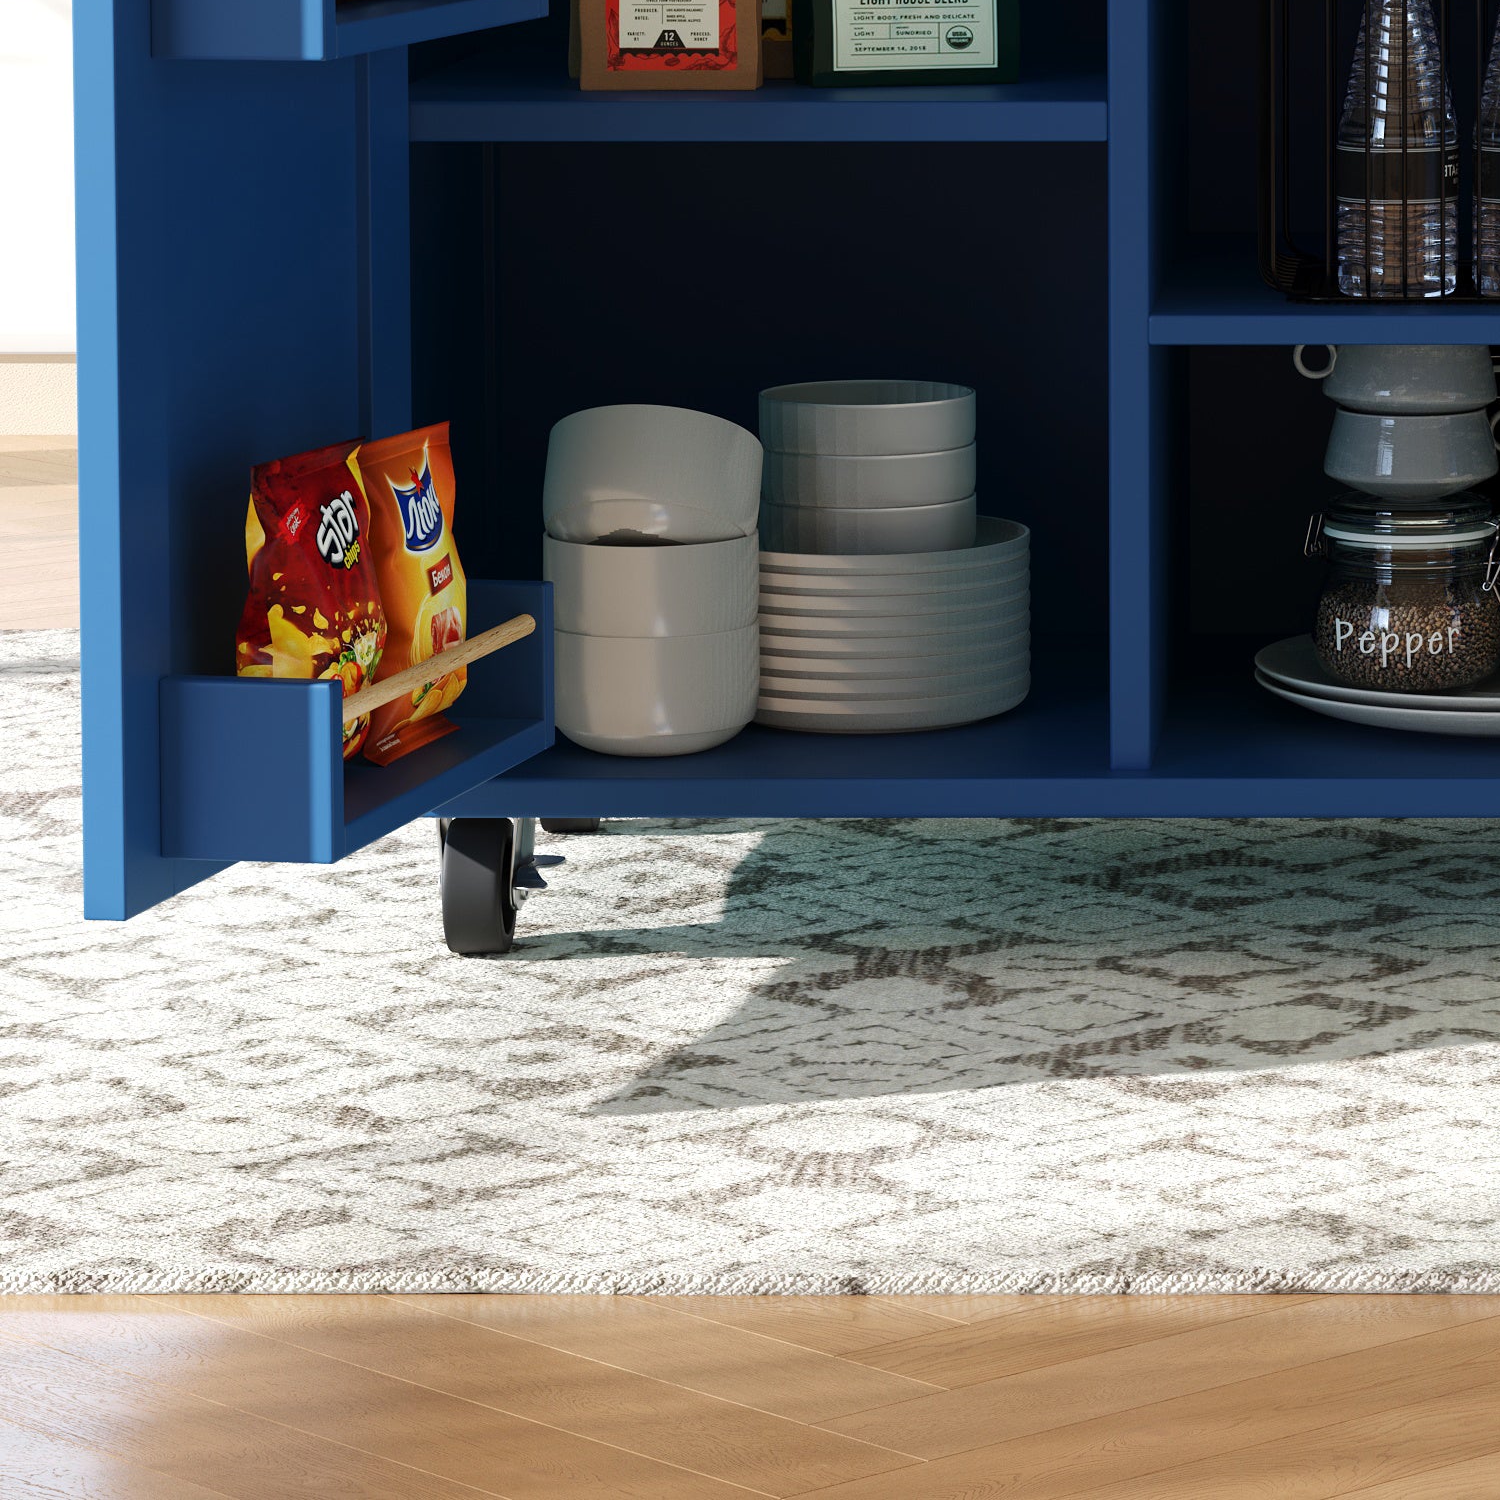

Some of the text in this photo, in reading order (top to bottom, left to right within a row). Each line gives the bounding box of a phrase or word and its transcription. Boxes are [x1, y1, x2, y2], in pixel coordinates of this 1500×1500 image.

[664, 32, 674, 40] 12
[344, 540, 360, 570] chips
[1335, 617, 1460, 668] Pepper
